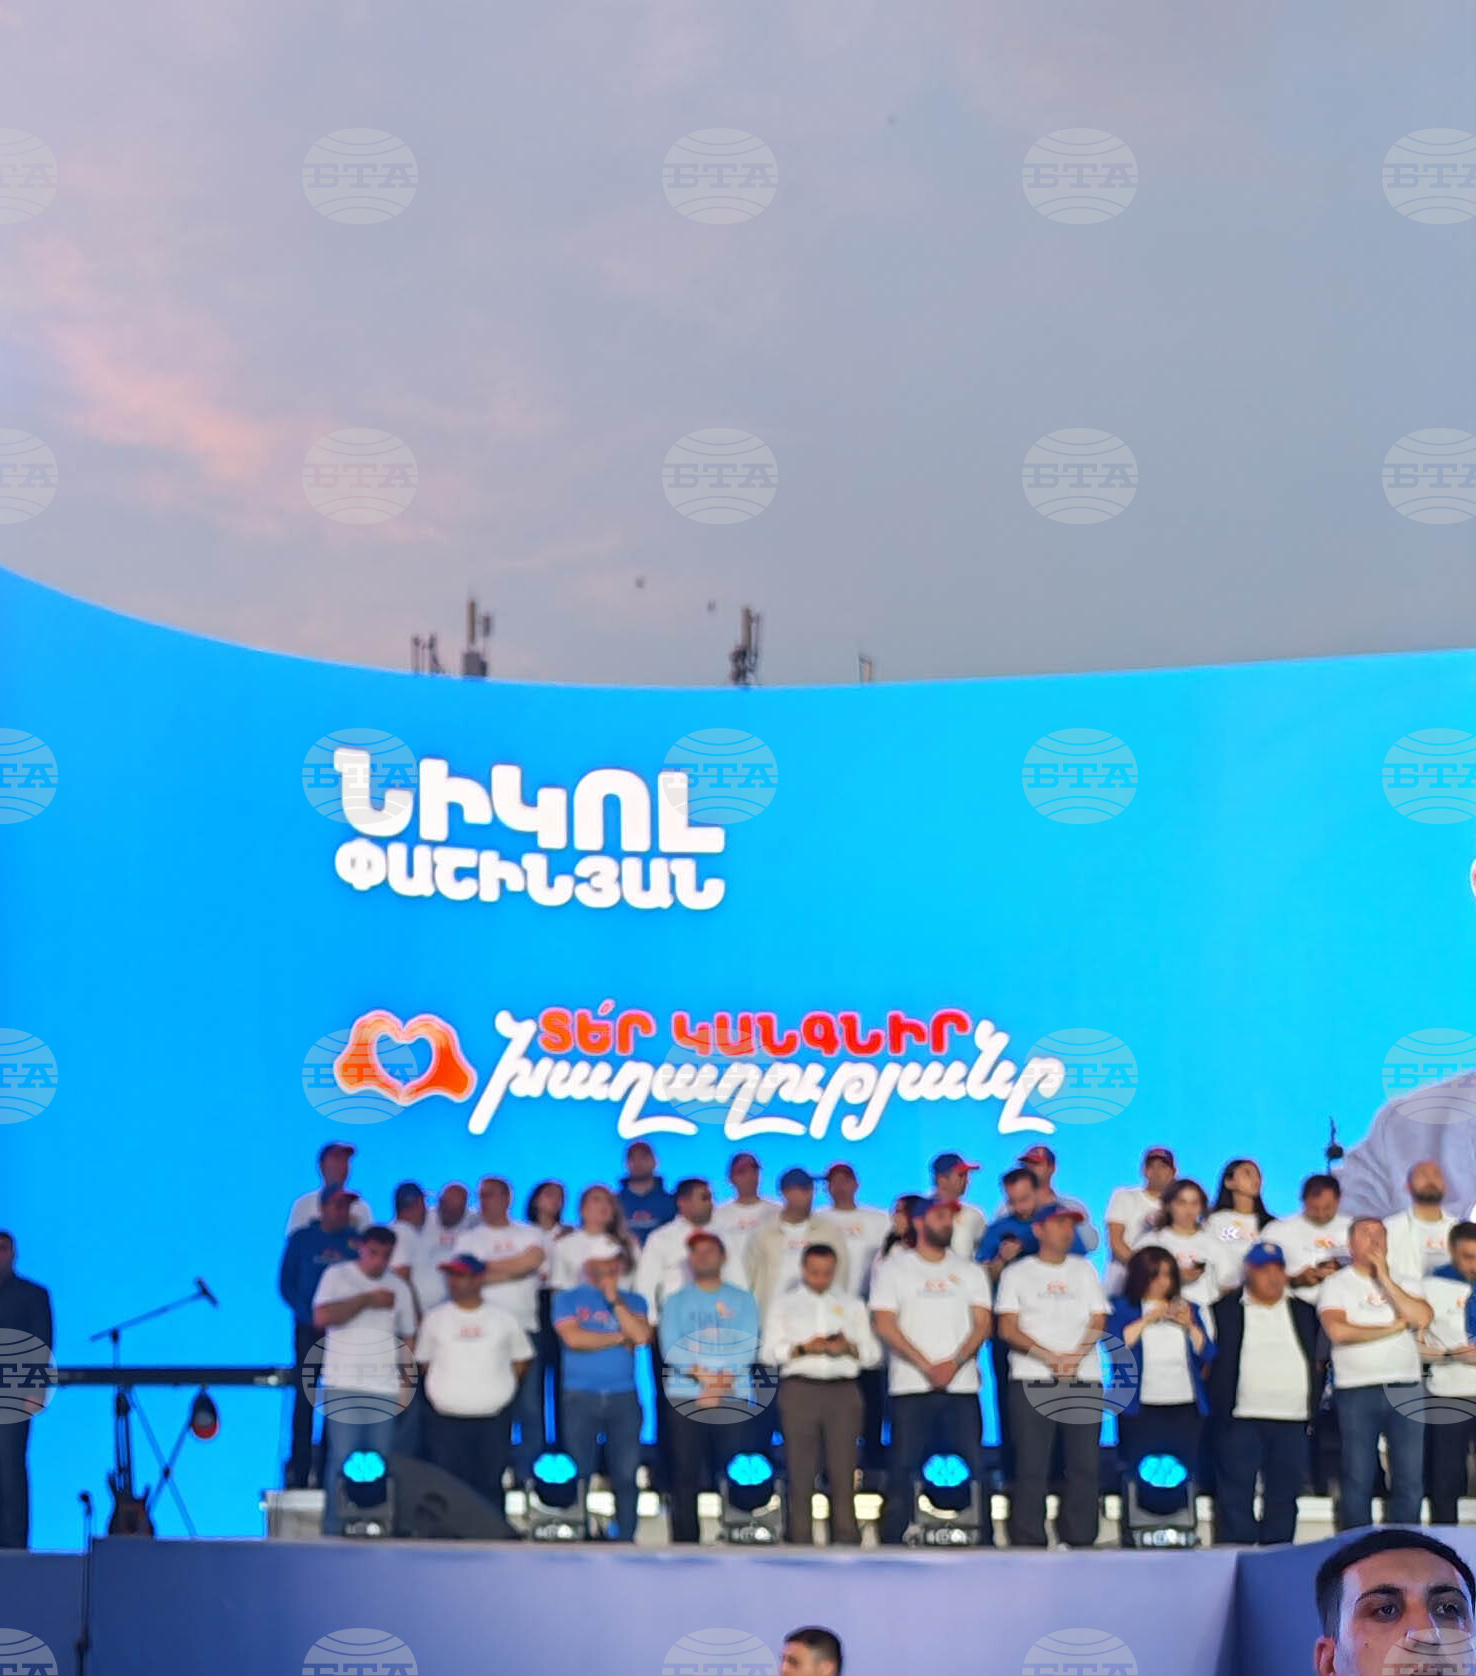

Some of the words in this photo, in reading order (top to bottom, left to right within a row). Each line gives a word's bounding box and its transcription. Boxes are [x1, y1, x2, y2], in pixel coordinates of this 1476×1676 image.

[334, 748, 725, 854] ՆԻԿՈԼ
[335, 838, 725, 910] ՓԱՇԻՆՅԱՆ
[672, 1008, 971, 1057] ԿԱՆԳՆԻՐ
